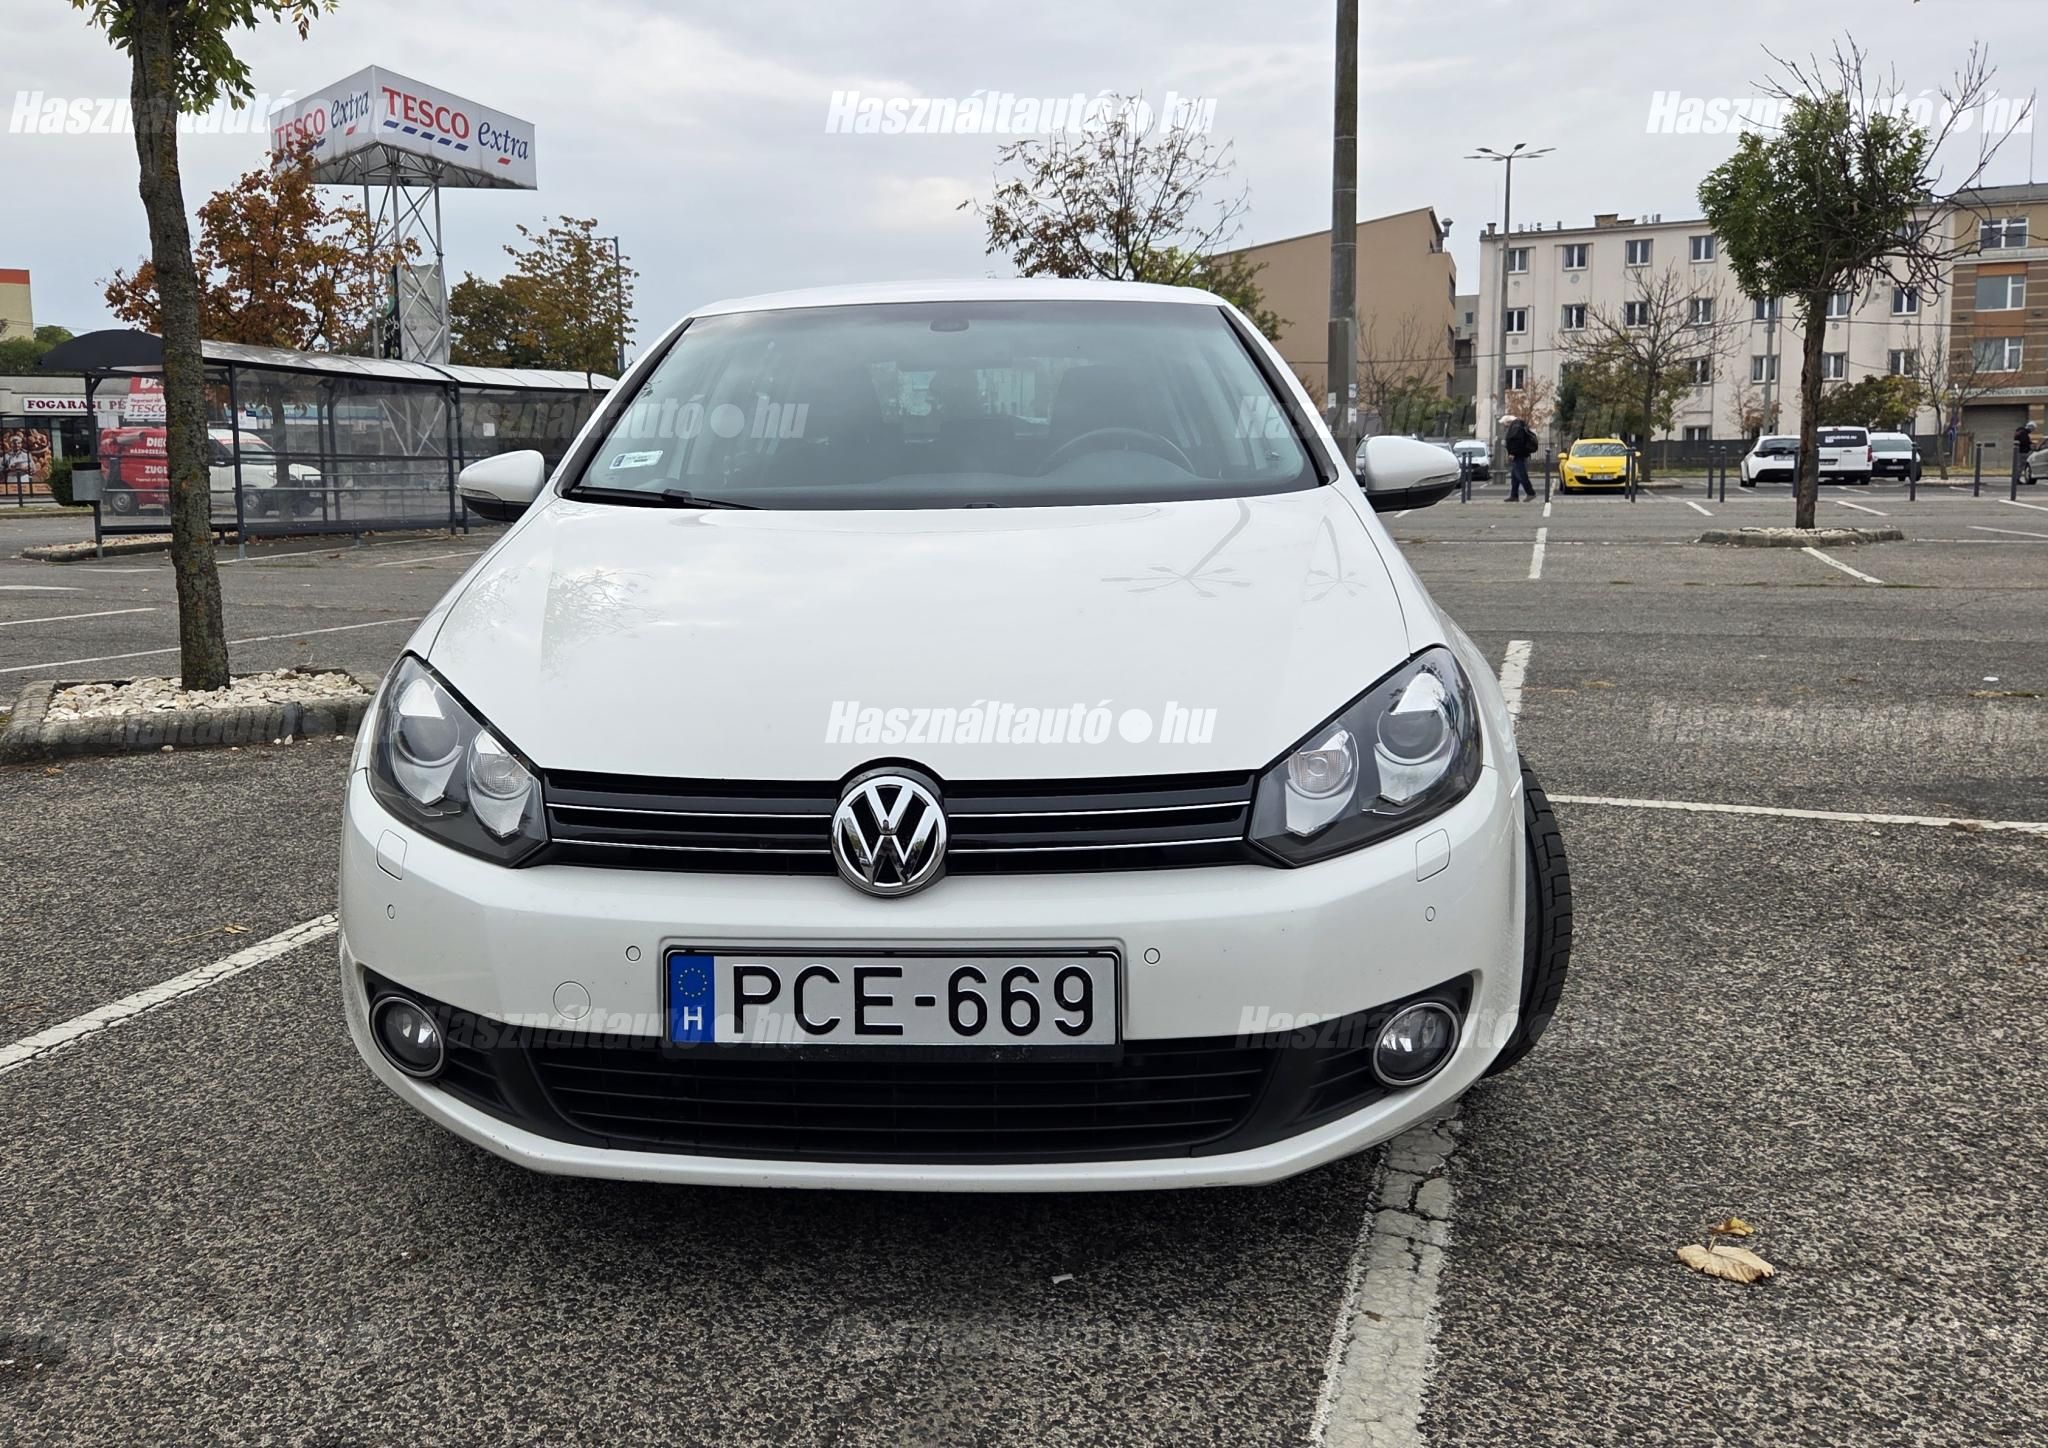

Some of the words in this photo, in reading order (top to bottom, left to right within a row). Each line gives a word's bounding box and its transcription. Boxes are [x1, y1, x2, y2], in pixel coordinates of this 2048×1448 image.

[274, 108, 325, 150] TESCO
[331, 90, 369, 128] extra
[382, 86, 470, 139] TESCO
[478, 122, 529, 160] extra
[130, 404, 166, 413] TESCO
[683, 1006, 702, 1031] H
[733, 965, 1093, 1036] PCE-669
